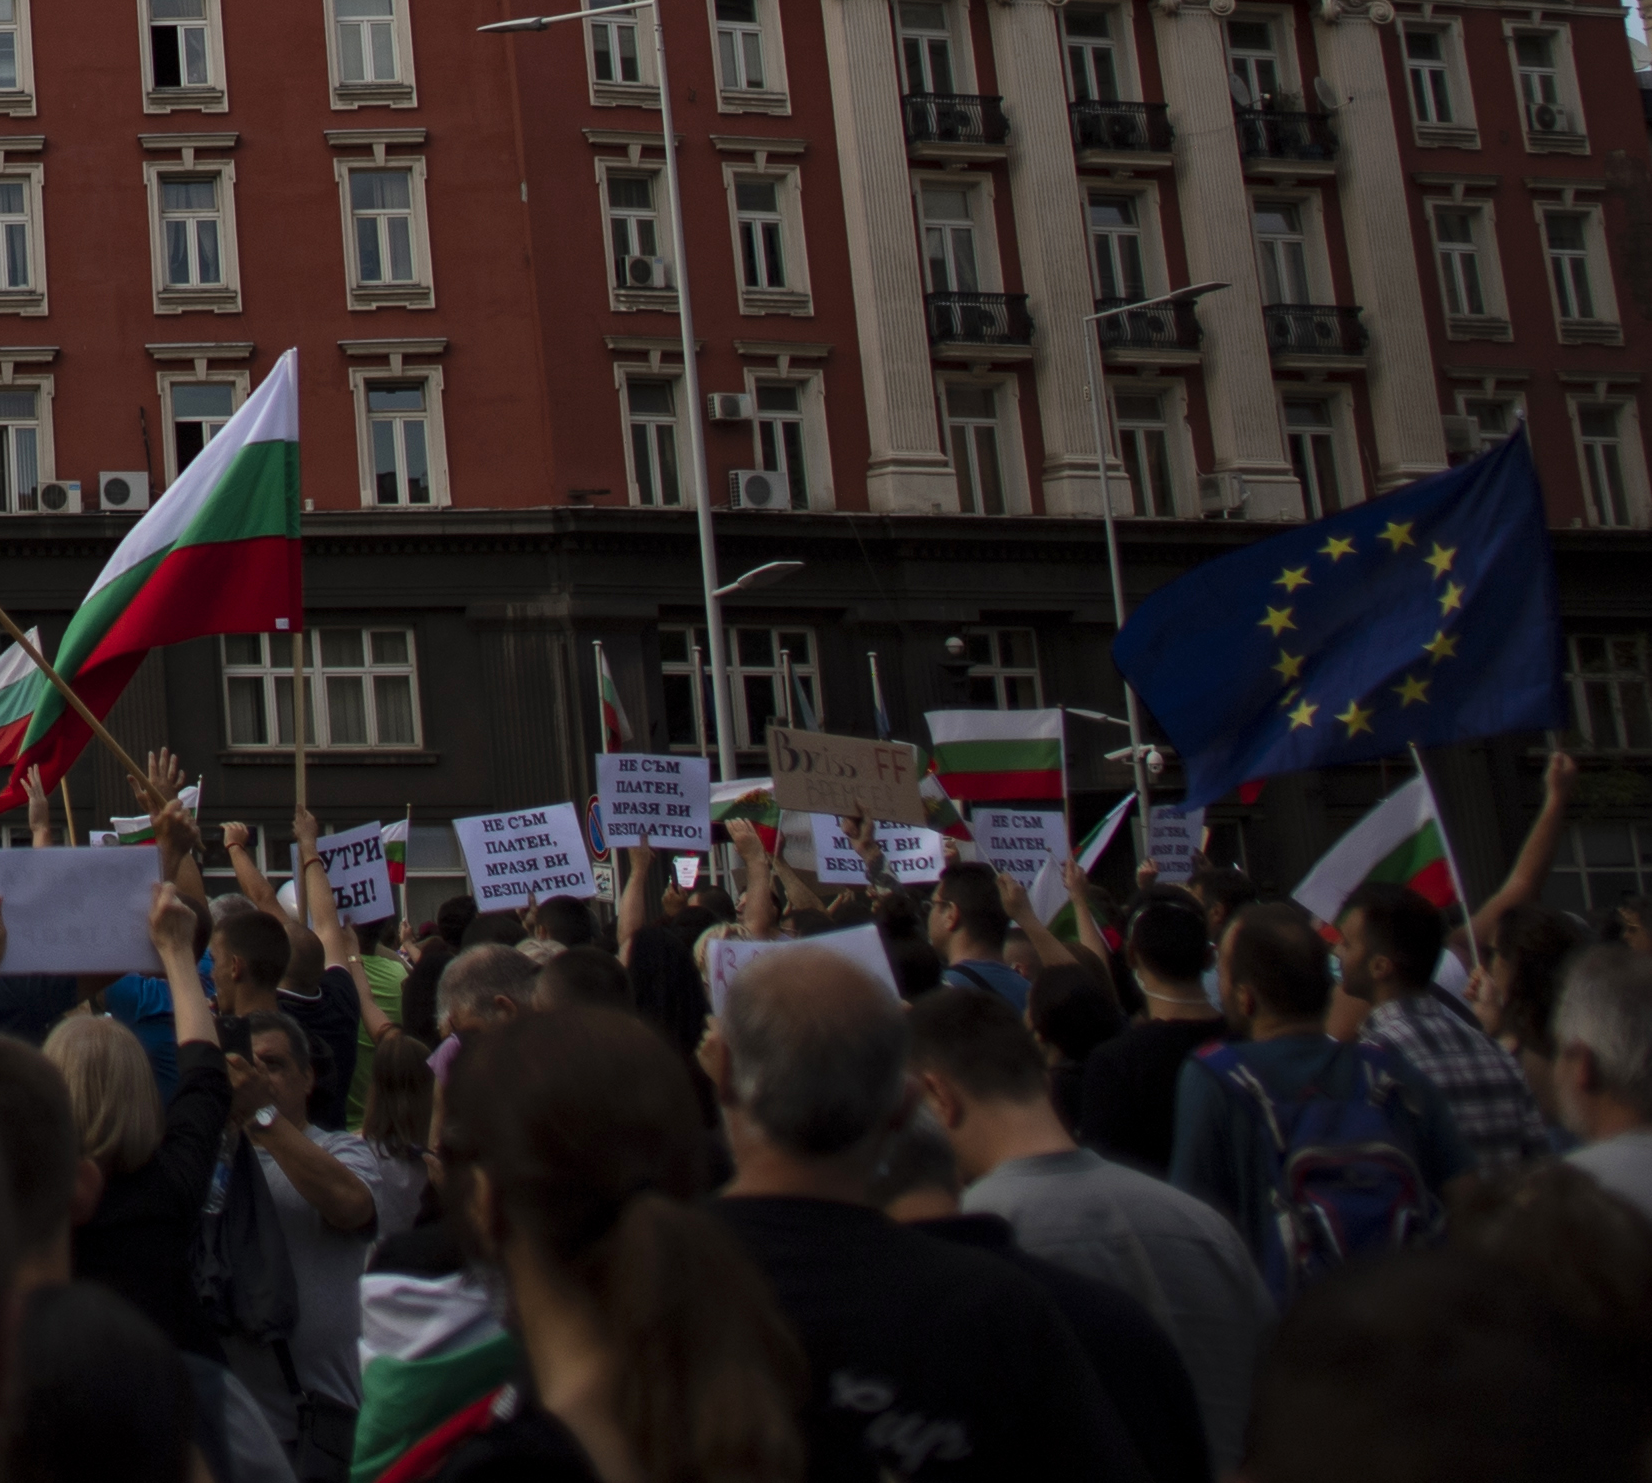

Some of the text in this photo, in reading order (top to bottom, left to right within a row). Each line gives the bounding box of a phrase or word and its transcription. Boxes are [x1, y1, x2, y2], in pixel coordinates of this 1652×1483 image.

[619, 759, 681, 774] НЕ СЪМ
[616, 780, 684, 797] ПЛАТЕН,
[612, 802, 691, 817] МРАЗЯ ВИ
[482, 812, 548, 833] НЕ СЪМ
[607, 822, 703, 839] БЕЗПЛАТНО!
[991, 815, 1044, 829] НЕ СЪМ
[484, 833, 558, 855] ПЛАТЕН,
[894, 837, 921, 851] ВИ
[318, 835, 383, 873] УТРИ
[485, 853, 570, 876] МРАЗЯ ВИ
[825, 855, 935, 873] БЕЗТНО!
[331, 878, 377, 909] ЪН!
[481, 872, 586, 899] БЕЗПЛАТНО!
